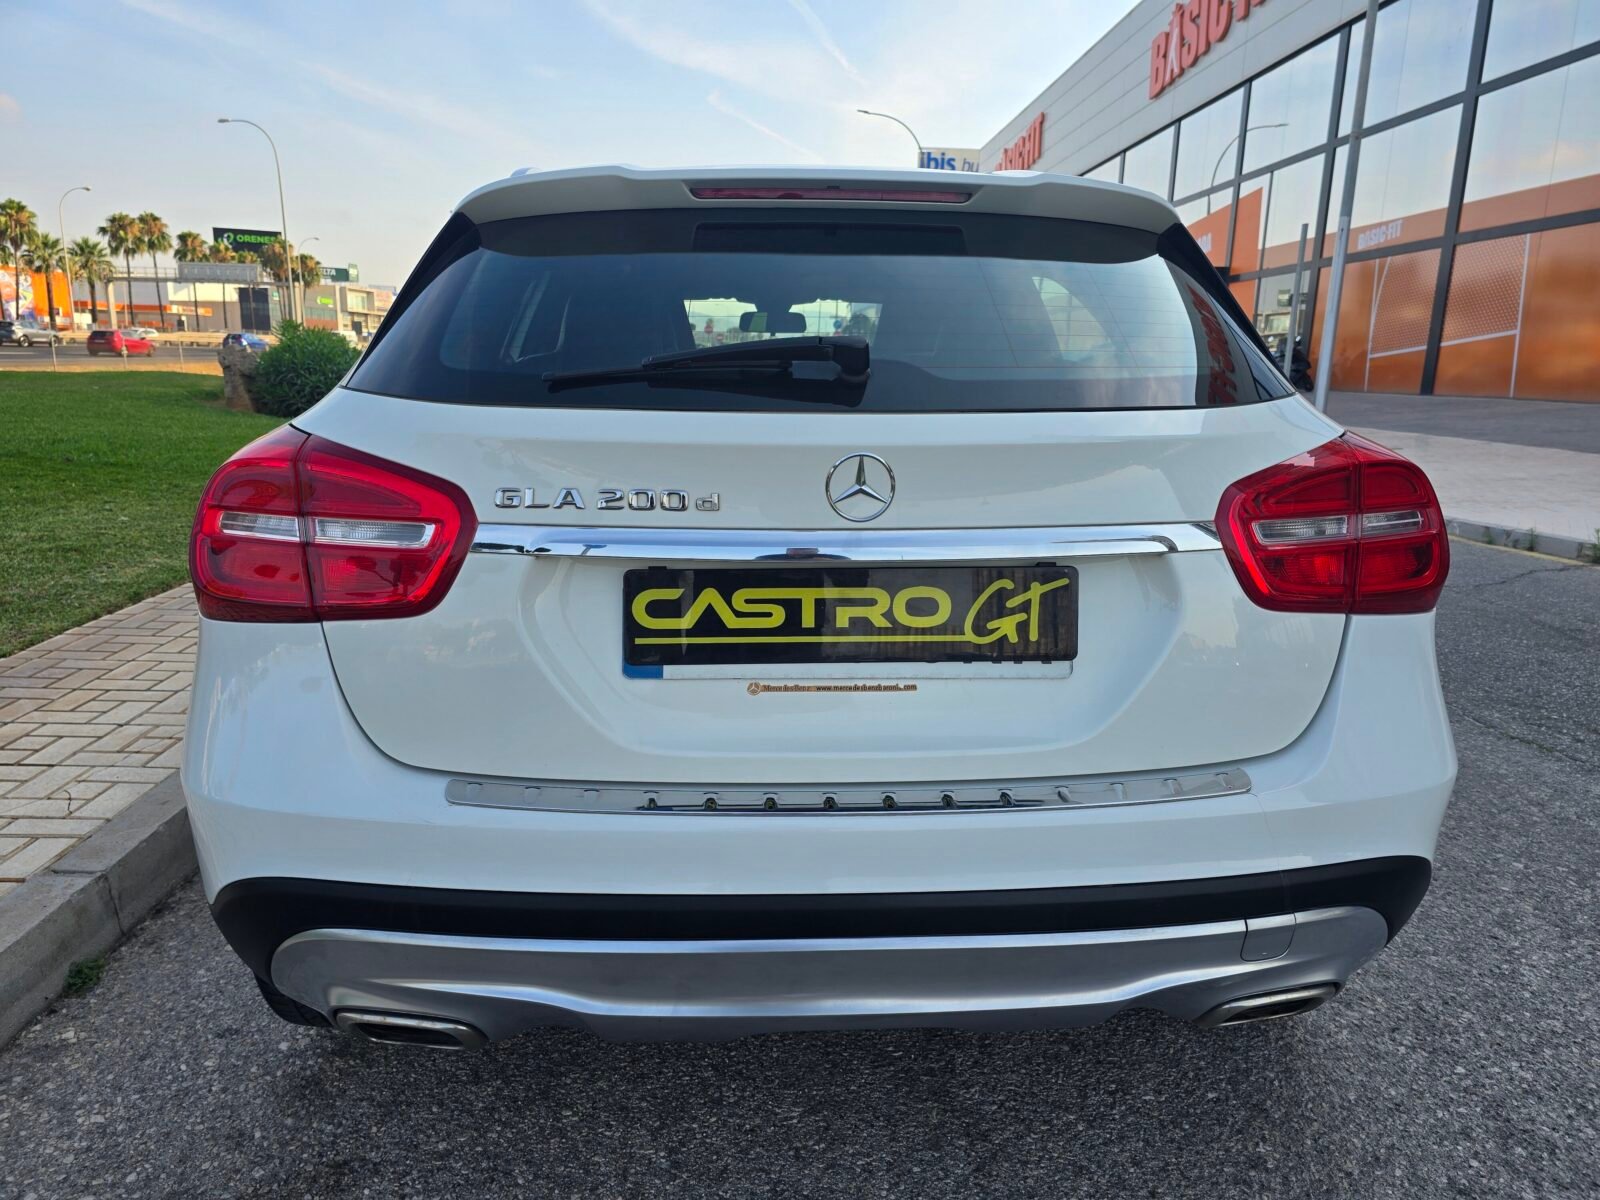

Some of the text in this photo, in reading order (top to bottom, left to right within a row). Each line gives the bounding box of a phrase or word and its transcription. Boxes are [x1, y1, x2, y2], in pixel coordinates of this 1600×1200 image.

[1147, 0, 1266, 100] BASIC
[495, 487, 720, 511] GLA 200 d
[631, 578, 1070, 645] CASTRO GT
